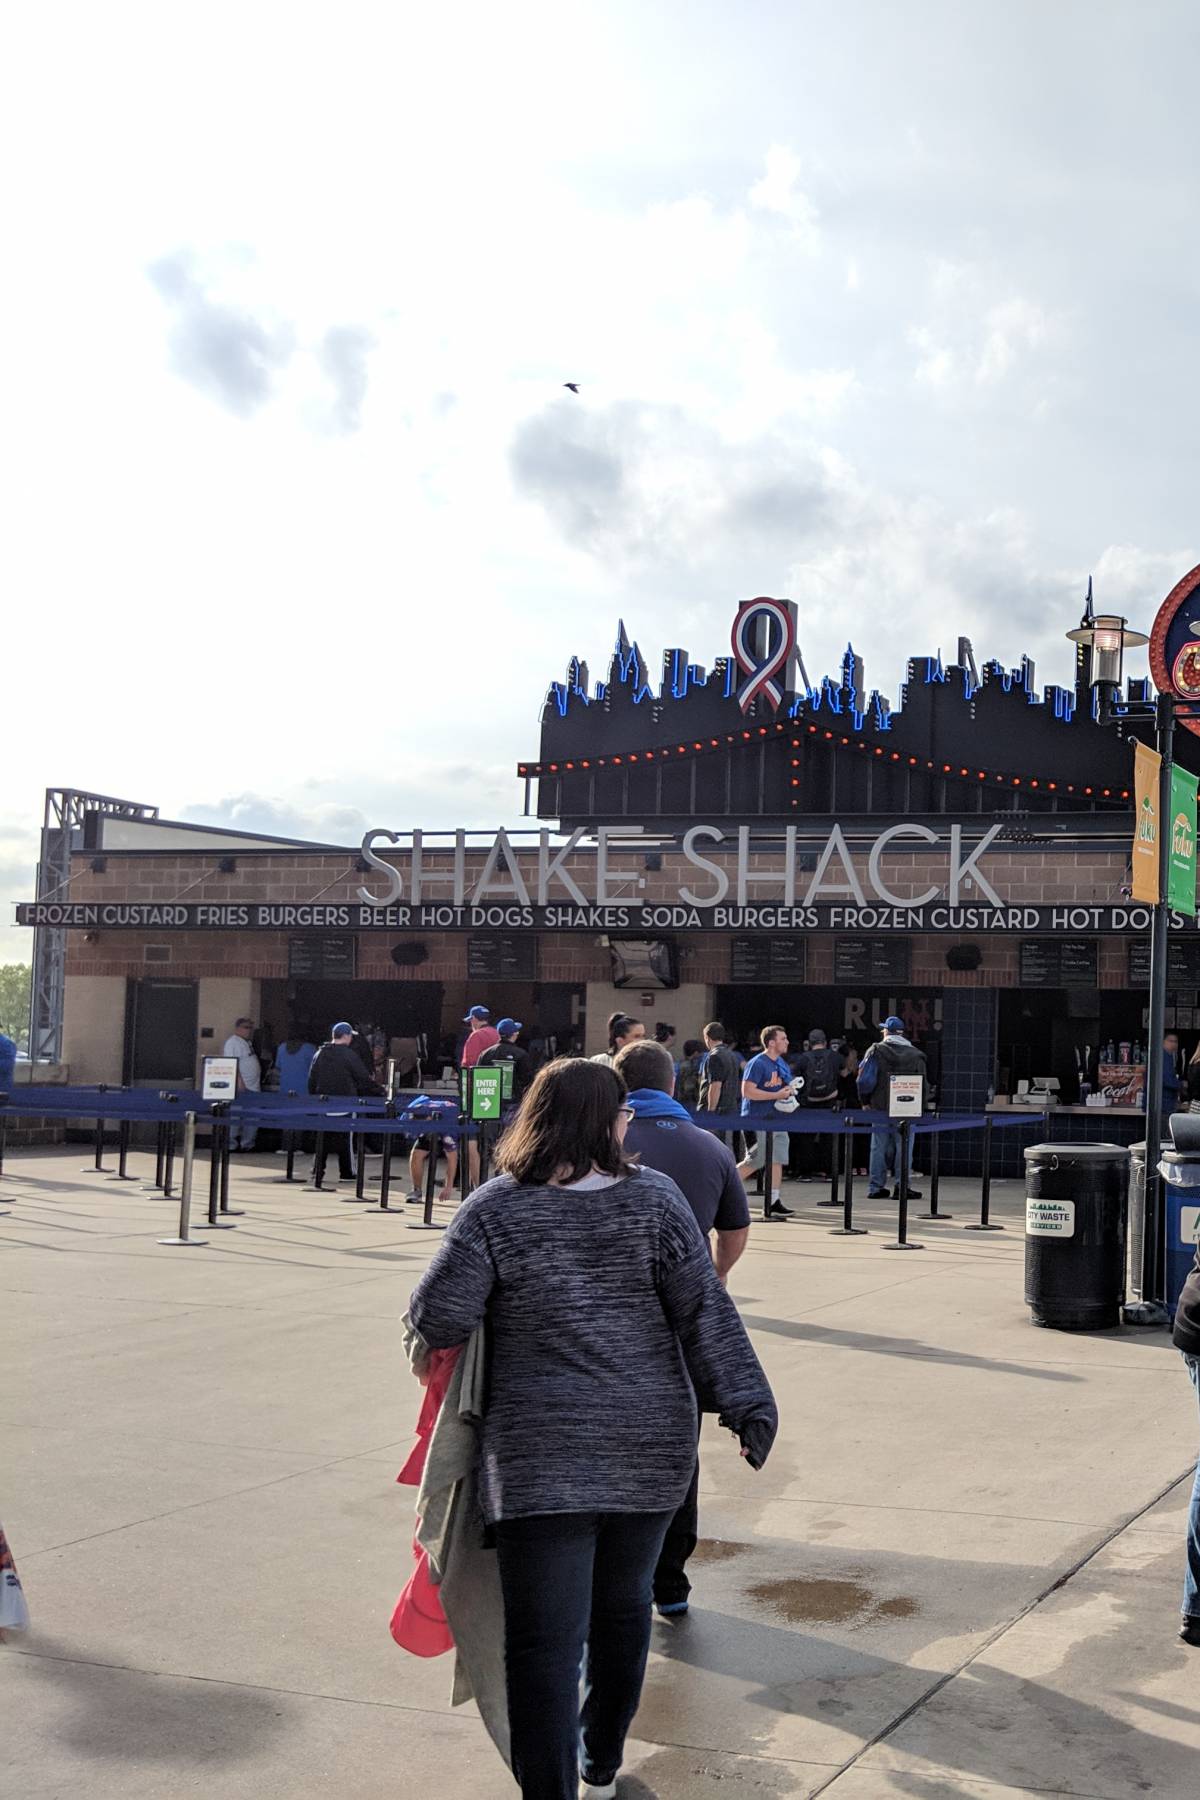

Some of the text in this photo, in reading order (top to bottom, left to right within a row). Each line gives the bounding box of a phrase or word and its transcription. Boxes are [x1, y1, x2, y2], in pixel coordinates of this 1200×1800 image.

[356, 823, 1005, 908] SHAKE SHACK
[25, 905, 97, 924] FROZEN
[103, 905, 188, 925] CUSTARD
[197, 906, 248, 926] FRIES
[258, 906, 349, 926] BURGERS
[359, 907, 410, 926] BEER
[421, 907, 465, 926] HOT
[472, 907, 534, 927] DOGS
[544, 907, 629, 927] SHAKES
[641, 907, 701, 927] SODA
[713, 907, 818, 928] BURGERS
[830, 908, 923, 929] FROZEN
[931, 908, 1040, 929] CUSTARD
[1052, 908, 1104, 929] HOT
[1112, 908, 1185, 930] DOS
[475, 1079, 498, 1088] ENTER
[477, 1088, 496, 1096] HERE
[1040, 1211, 1071, 1221] WASTE
